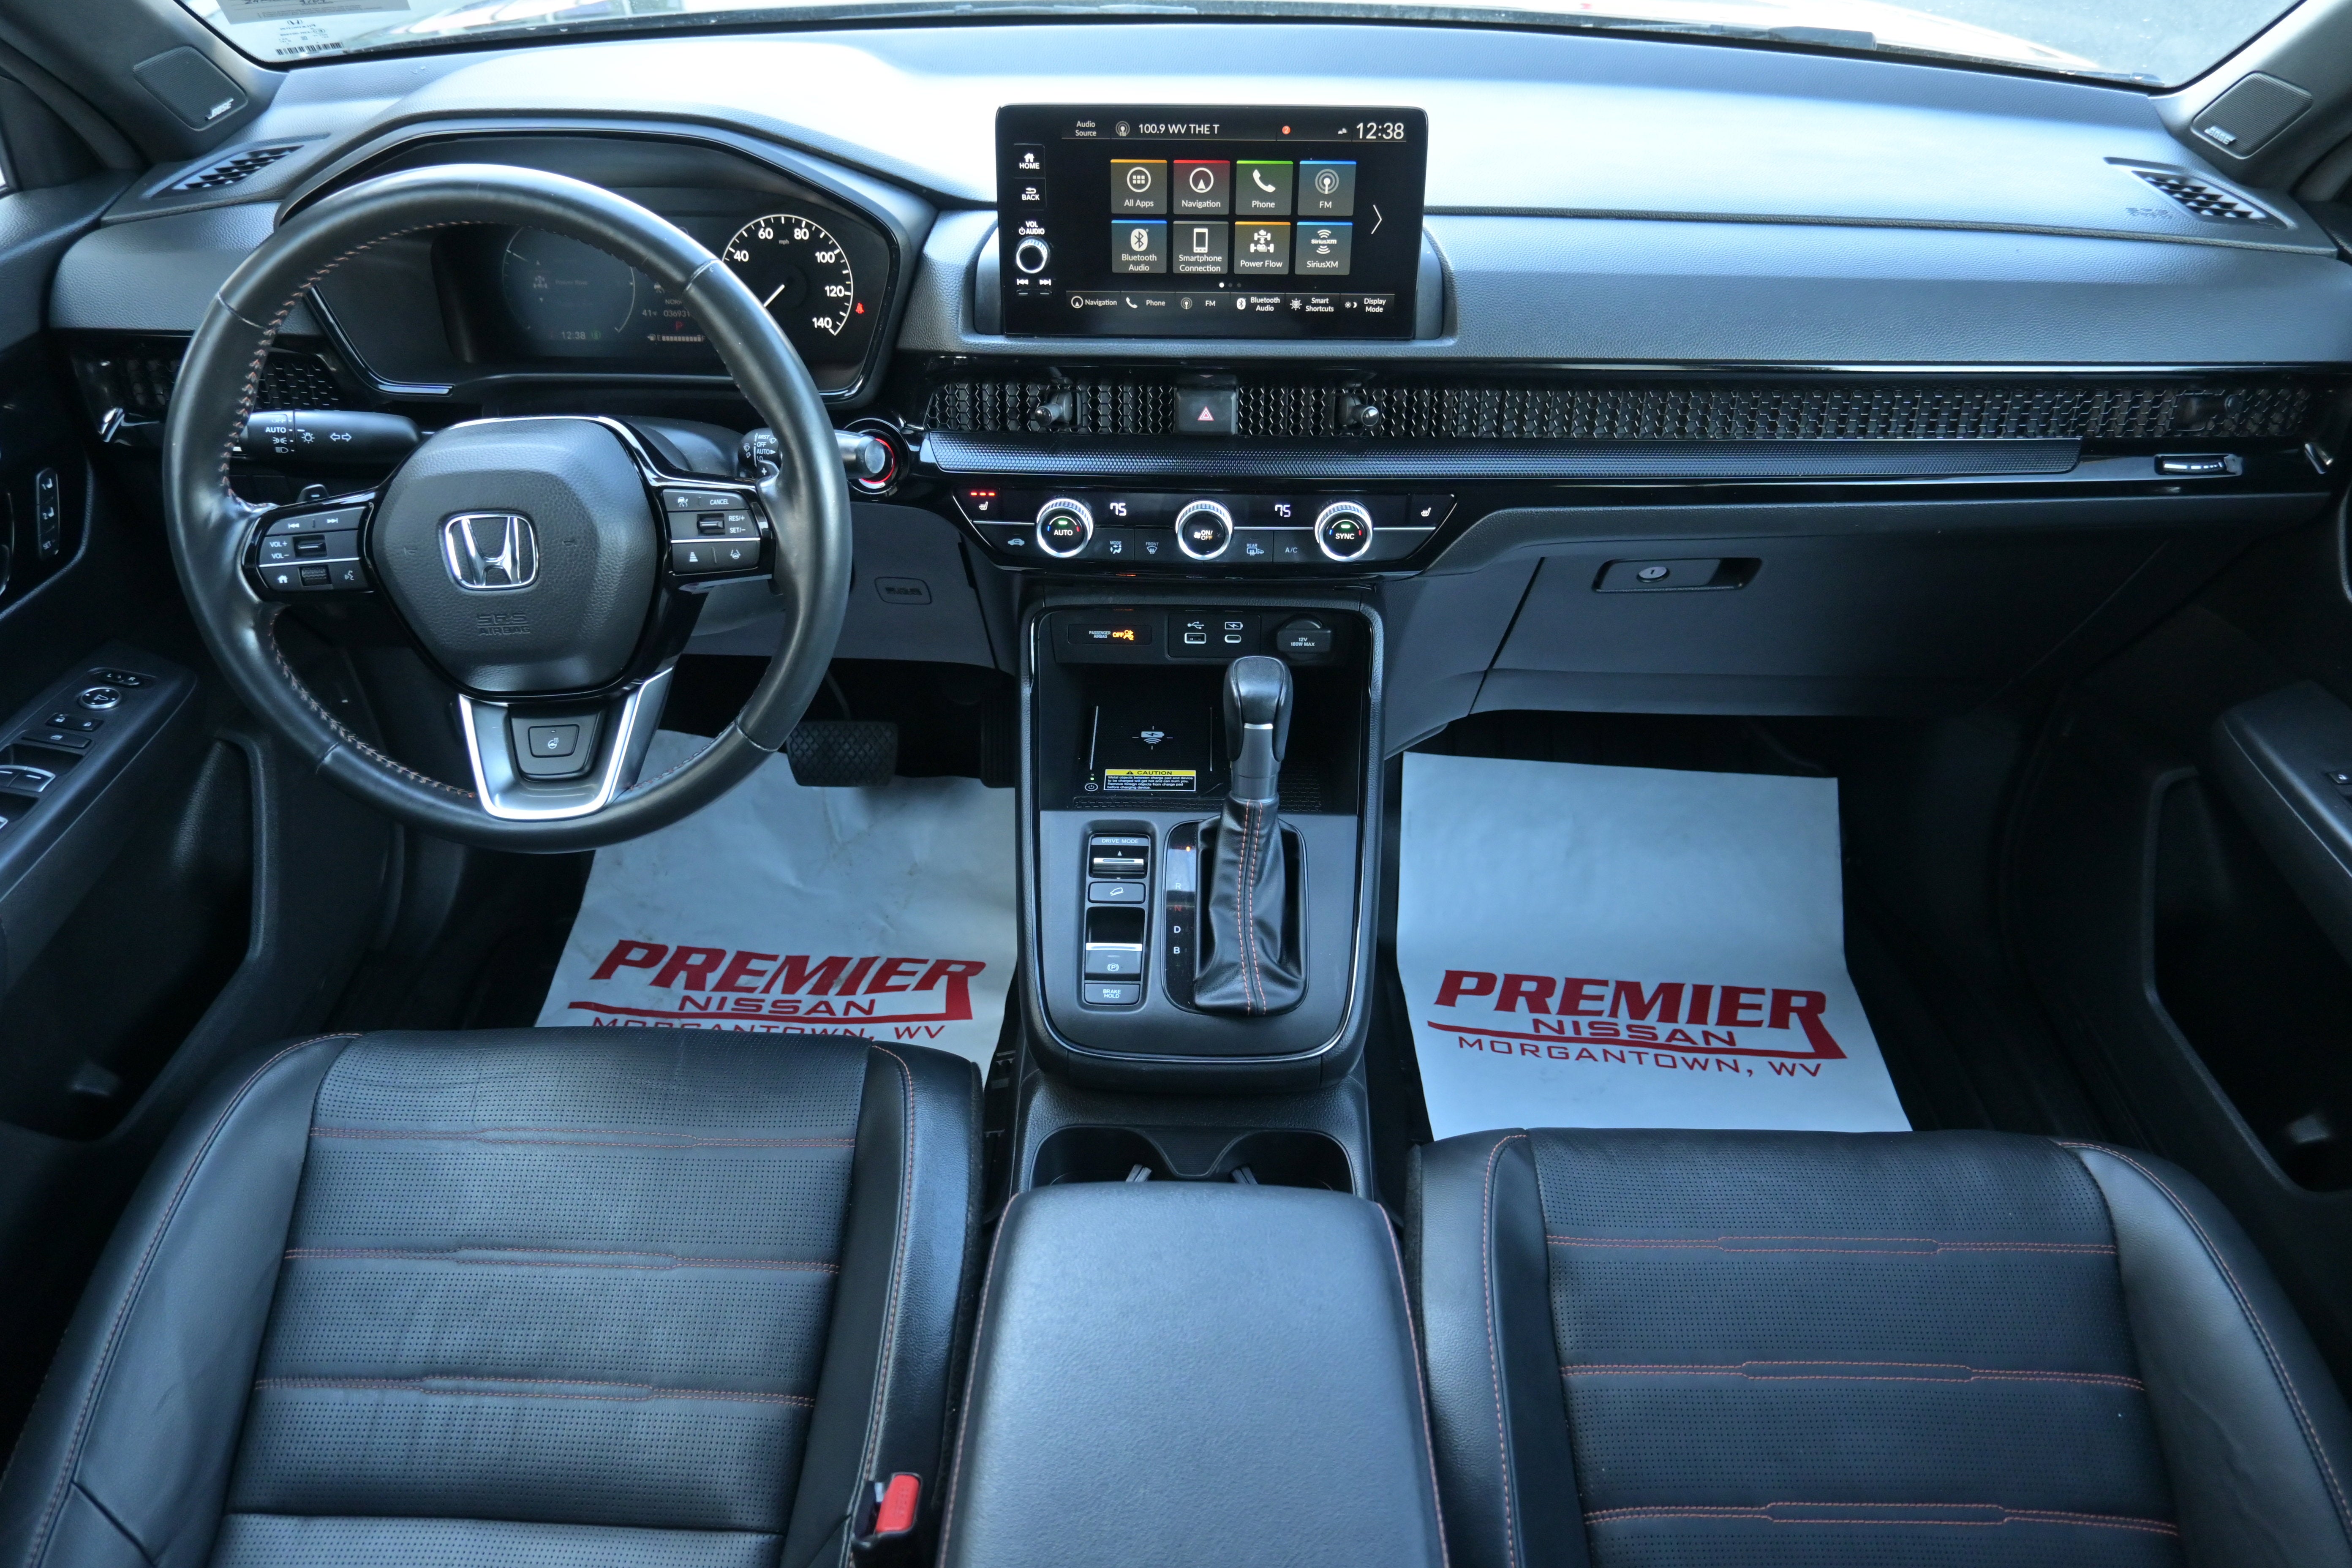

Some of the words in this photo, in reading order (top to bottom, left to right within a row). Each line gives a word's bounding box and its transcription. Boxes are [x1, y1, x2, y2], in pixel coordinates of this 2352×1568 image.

[1139, 124, 1165, 134] 100.9
[1168, 124, 1187, 134] WV
[1189, 125, 1210, 134] THE
[1212, 125, 1220, 134] T
[1356, 122, 1404, 139] 12:38
[1135, 199, 1154, 208] Apps
[1182, 200, 1220, 209] Navigation
[1252, 200, 1275, 208] Phone
[758, 228, 773, 239] 60
[794, 229, 809, 240] 80
[733, 250, 749, 262] 40
[815, 252, 835, 263] 100
[1179, 254, 1222, 263] Smartphone
[1307, 260, 1338, 268] SiriusXM
[825, 286, 844, 297] 120
[1364, 298, 1386, 306] Display
[812, 317, 832, 329] 140
[561, 331, 586, 340] 12:38
[1110, 503, 1127, 516] 75
[1275, 504, 1291, 517] 75
[590, 939, 986, 1019] PREMIER
[678, 995, 876, 1016] NISSAN
[1435, 969, 1847, 1059] PREMIER
[895, 1025, 946, 1040] WV
[1532, 1018, 1737, 1047] NISSAN
[1458, 1035, 1753, 1077] MORGANTOWN,
[1768, 1060, 1821, 1078] WV
